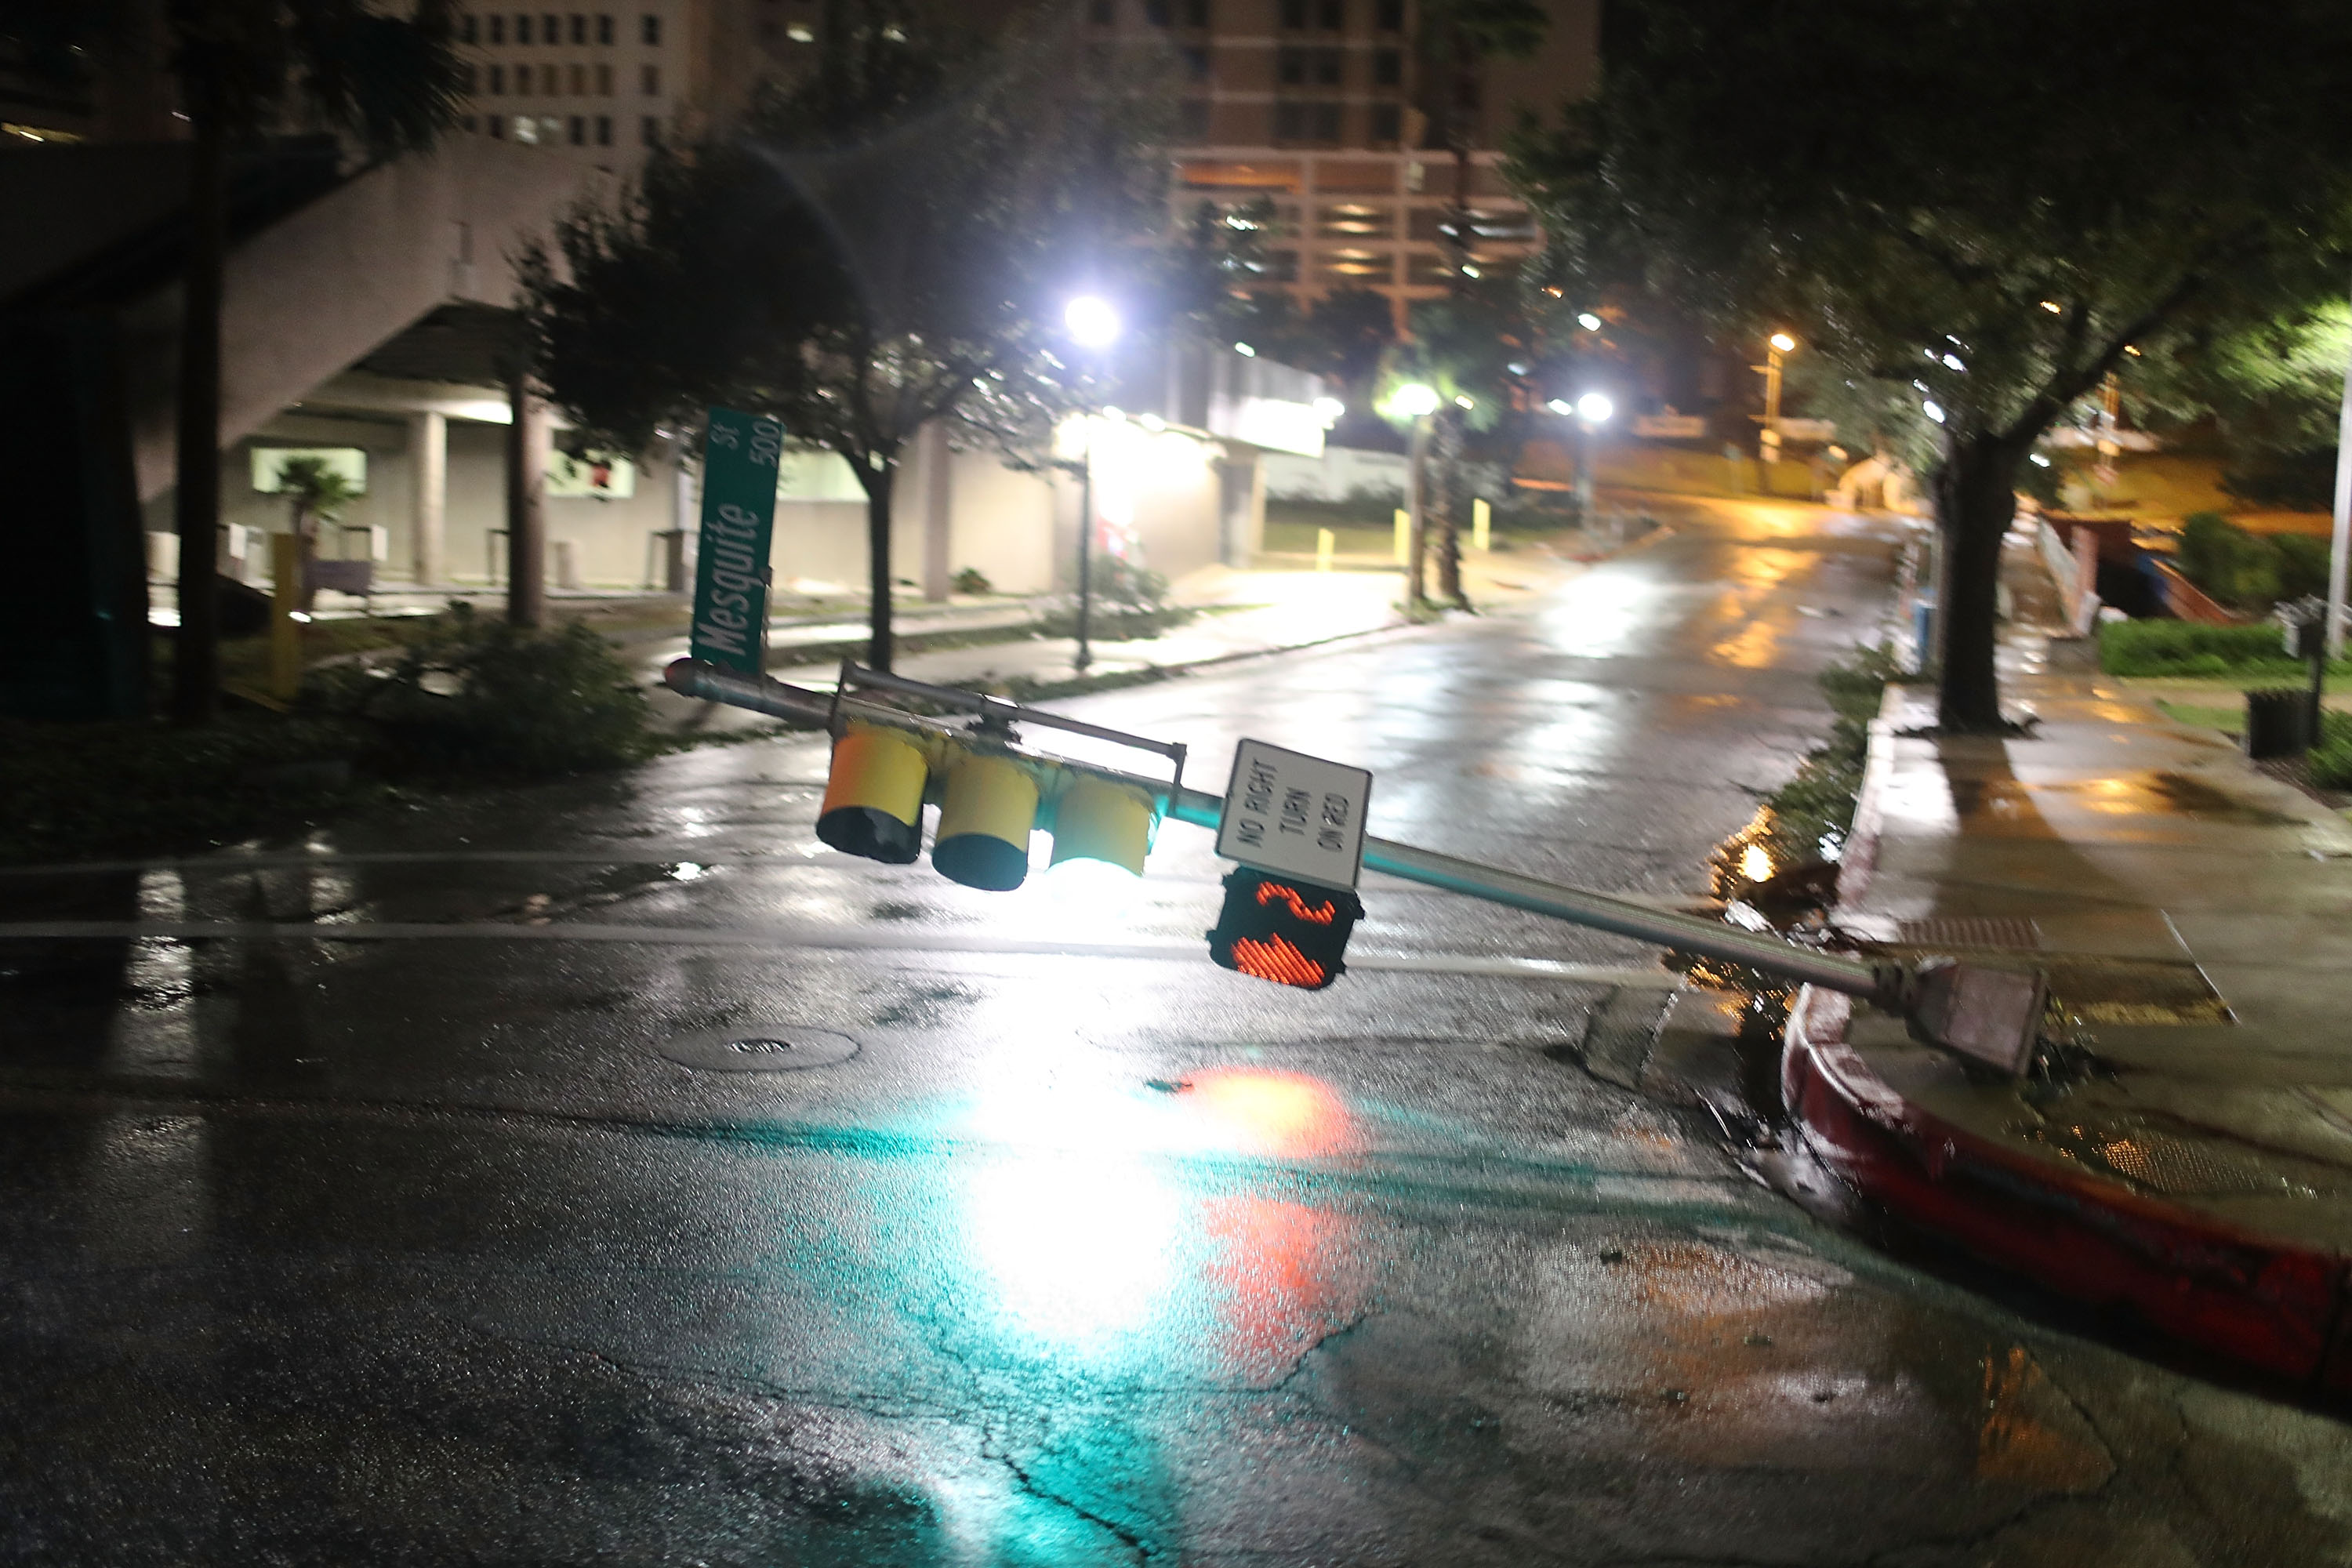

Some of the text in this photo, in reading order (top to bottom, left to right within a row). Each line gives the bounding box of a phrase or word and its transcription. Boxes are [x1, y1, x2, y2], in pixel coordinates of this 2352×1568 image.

[748, 420, 780, 469] 500
[695, 422, 764, 657] Mesquite St
[1236, 757, 1279, 849] NO RIGHT
[1279, 786, 1312, 836] TURN
[1316, 792, 1349, 852] ON RED
